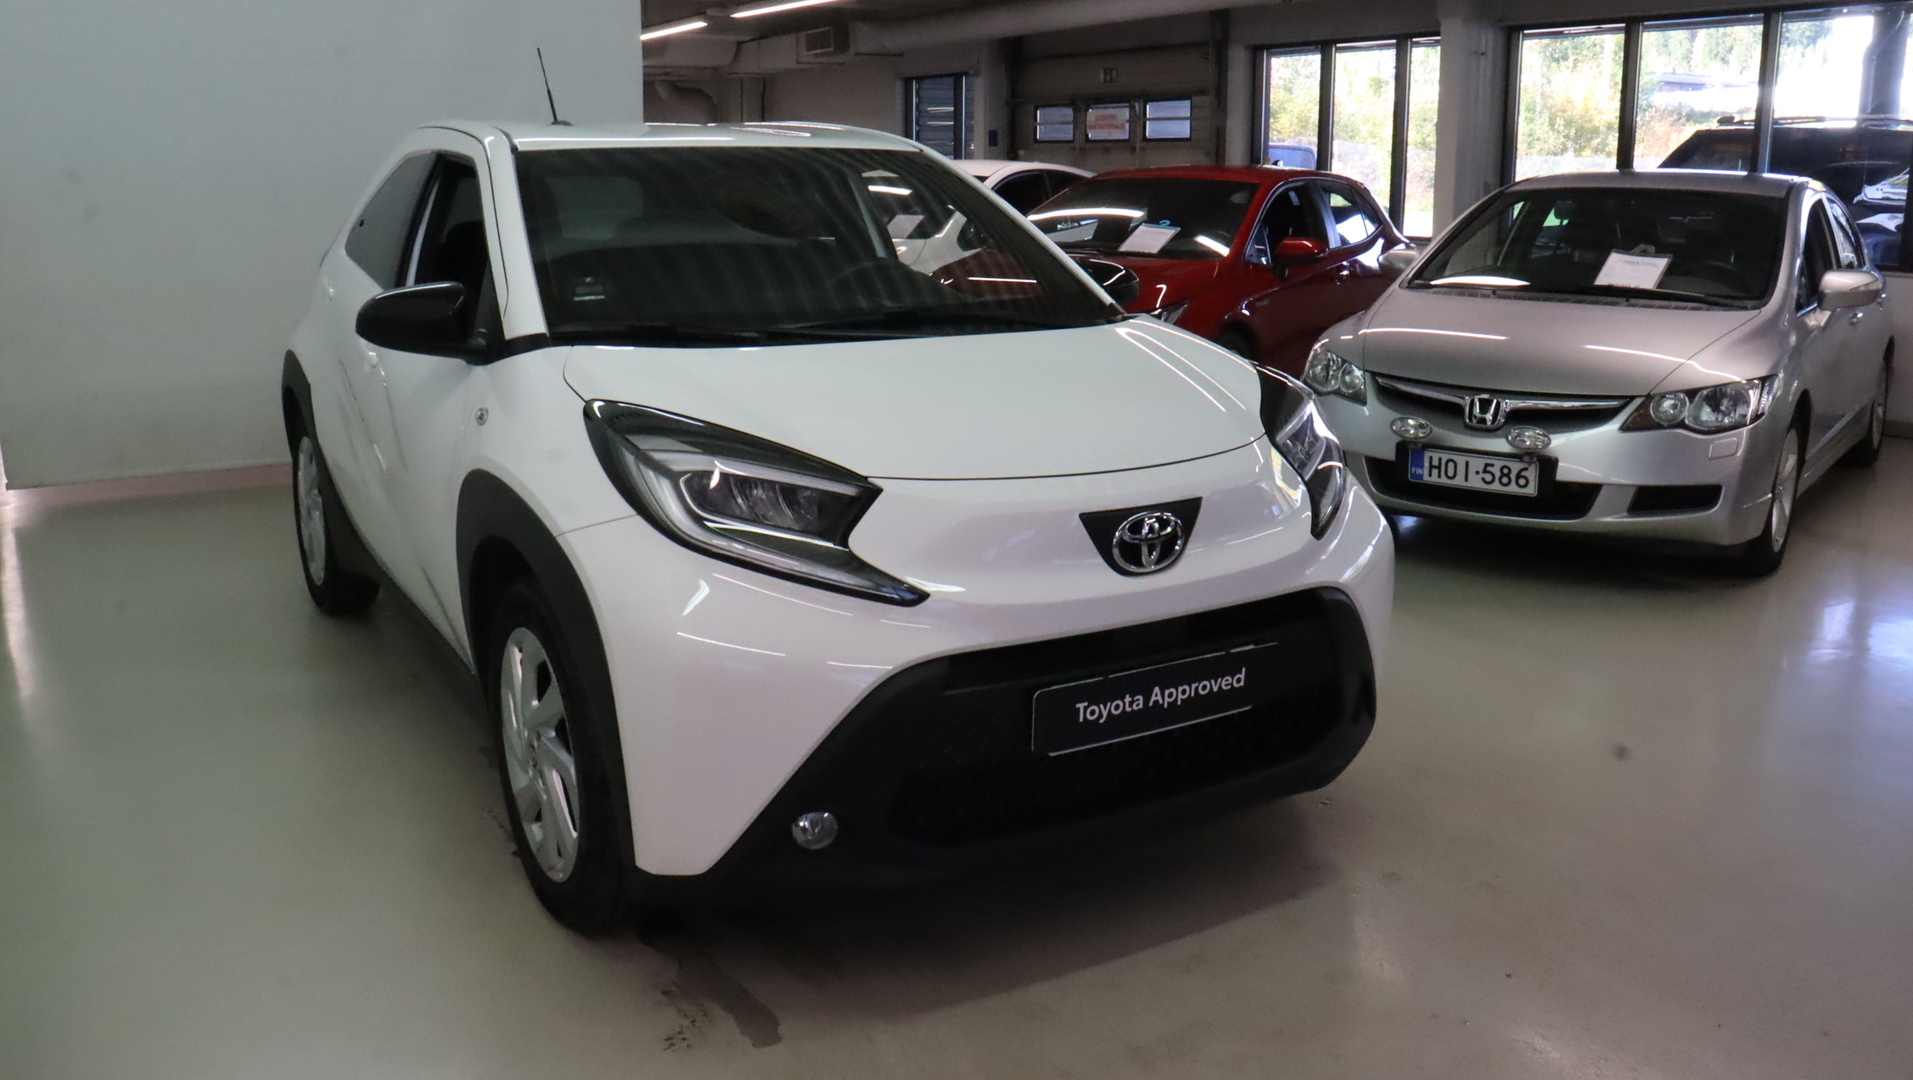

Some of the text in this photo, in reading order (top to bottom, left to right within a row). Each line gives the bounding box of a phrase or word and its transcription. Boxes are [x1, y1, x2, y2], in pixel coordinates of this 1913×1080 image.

[1411, 467, 1423, 475] FIN
[1428, 455, 1530, 489] HOI-586
[1076, 667, 1246, 724] Toyota Approved
